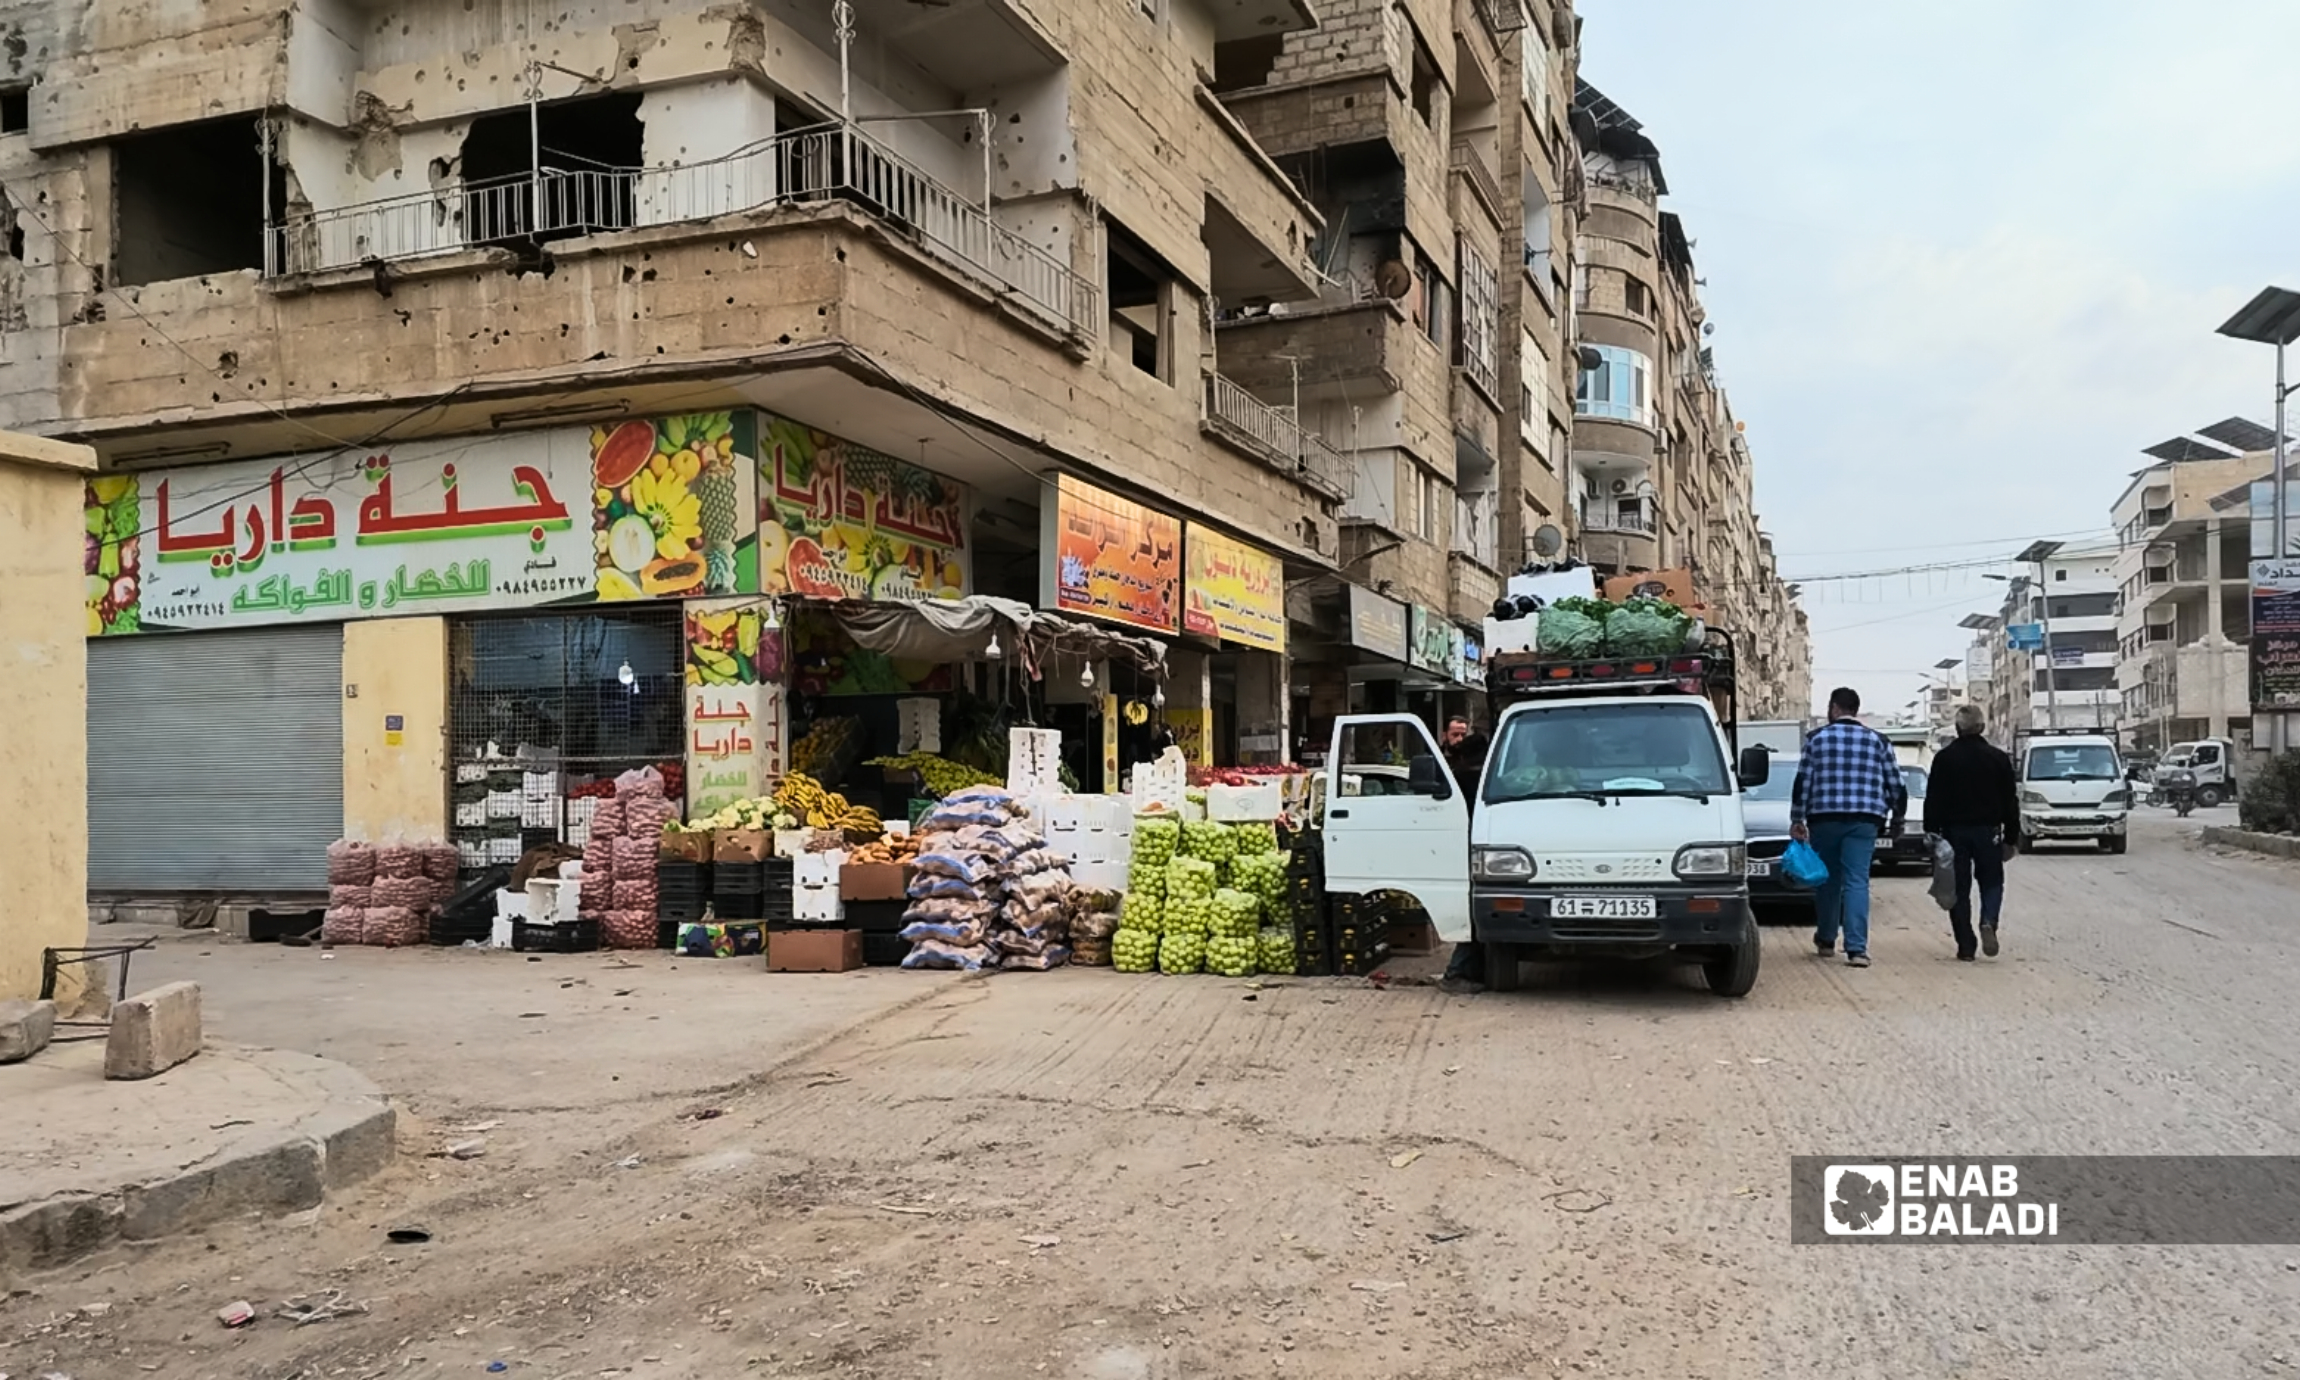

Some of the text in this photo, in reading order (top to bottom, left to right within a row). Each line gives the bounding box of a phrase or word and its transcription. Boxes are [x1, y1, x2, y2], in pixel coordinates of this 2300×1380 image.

[157, 454, 572, 578] جنة داريا
[773, 443, 954, 562] جنة داريا
[231, 568, 353, 614] الفواكه
[385, 559, 492, 607] للخضار
[694, 695, 751, 728] جنة
[693, 727, 753, 762] داريا
[1557, 899, 1577, 915] 61
[1598, 899, 1651, 916] 71135
